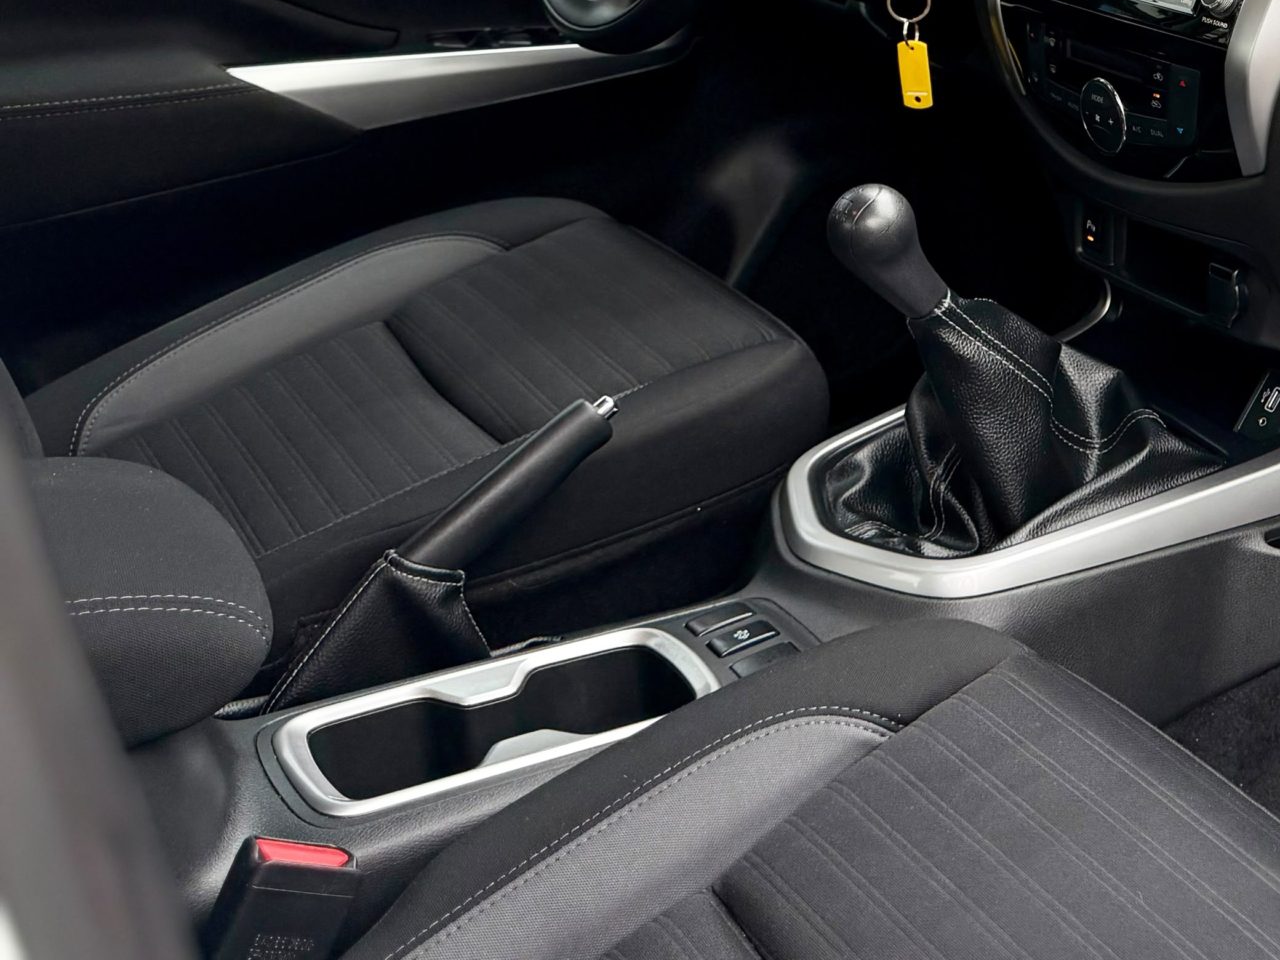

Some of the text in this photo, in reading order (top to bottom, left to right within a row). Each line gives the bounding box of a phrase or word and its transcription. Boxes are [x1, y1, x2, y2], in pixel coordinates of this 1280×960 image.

[1201, 16, 1229, 29] PUSH SOUND
[1091, 93, 1104, 104] MODE
[1150, 128, 1164, 138] DUAL
